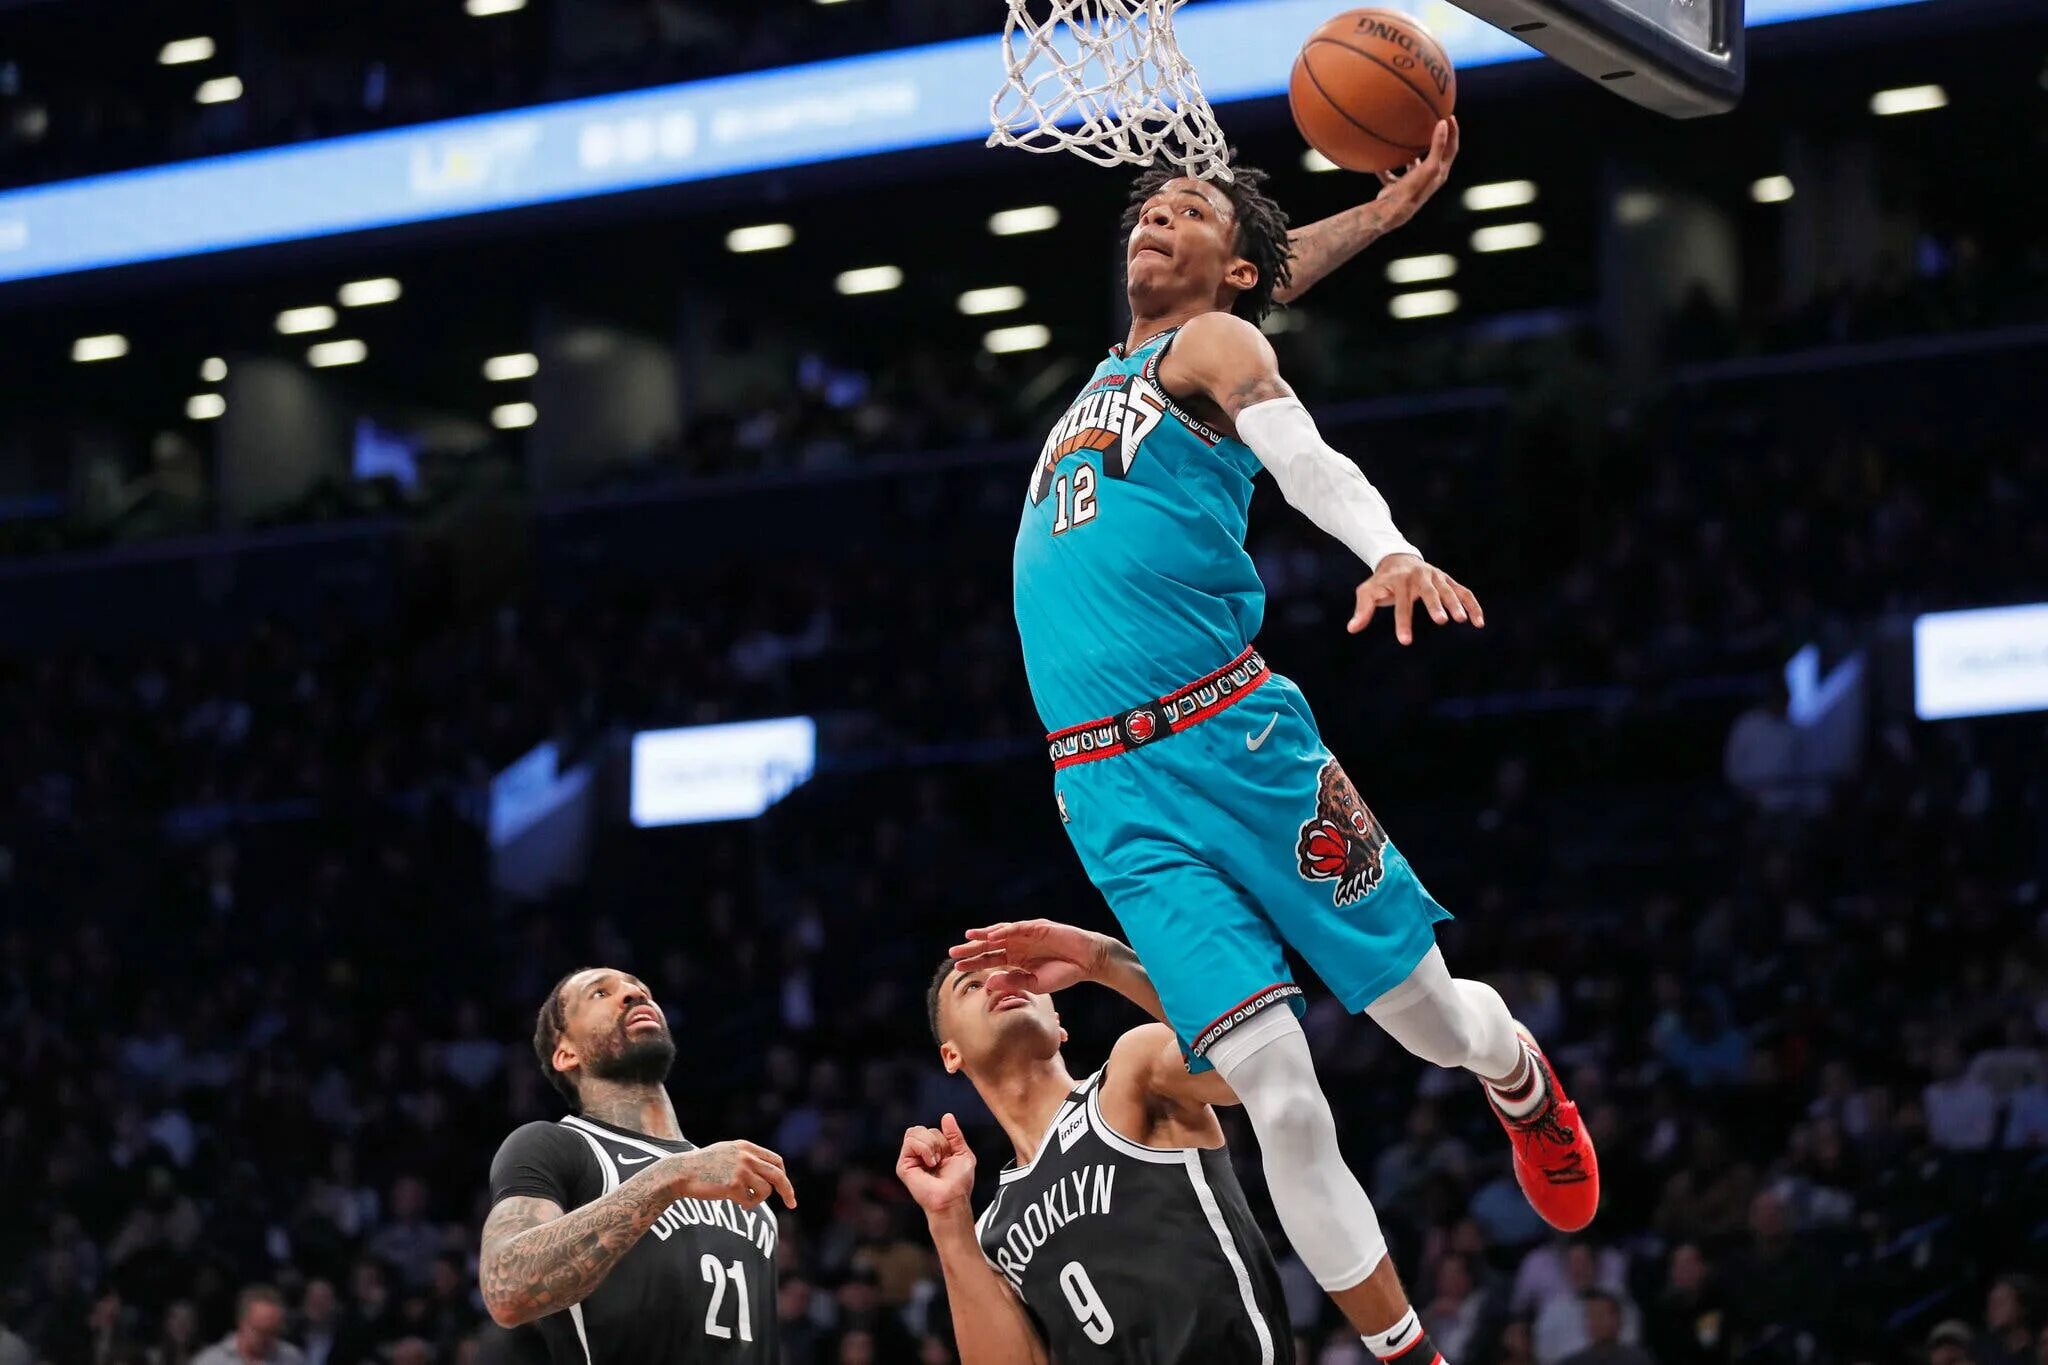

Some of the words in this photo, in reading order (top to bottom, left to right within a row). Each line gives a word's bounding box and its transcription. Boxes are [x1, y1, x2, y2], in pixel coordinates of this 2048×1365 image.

[1355, 17, 1453, 96] PADING
[1053, 462, 1097, 537] 12
[1061, 1115, 1084, 1140] infor
[996, 1164, 1116, 1302] ROOKLYN
[700, 1254, 753, 1342] 21
[1059, 1260, 1115, 1345] 9
